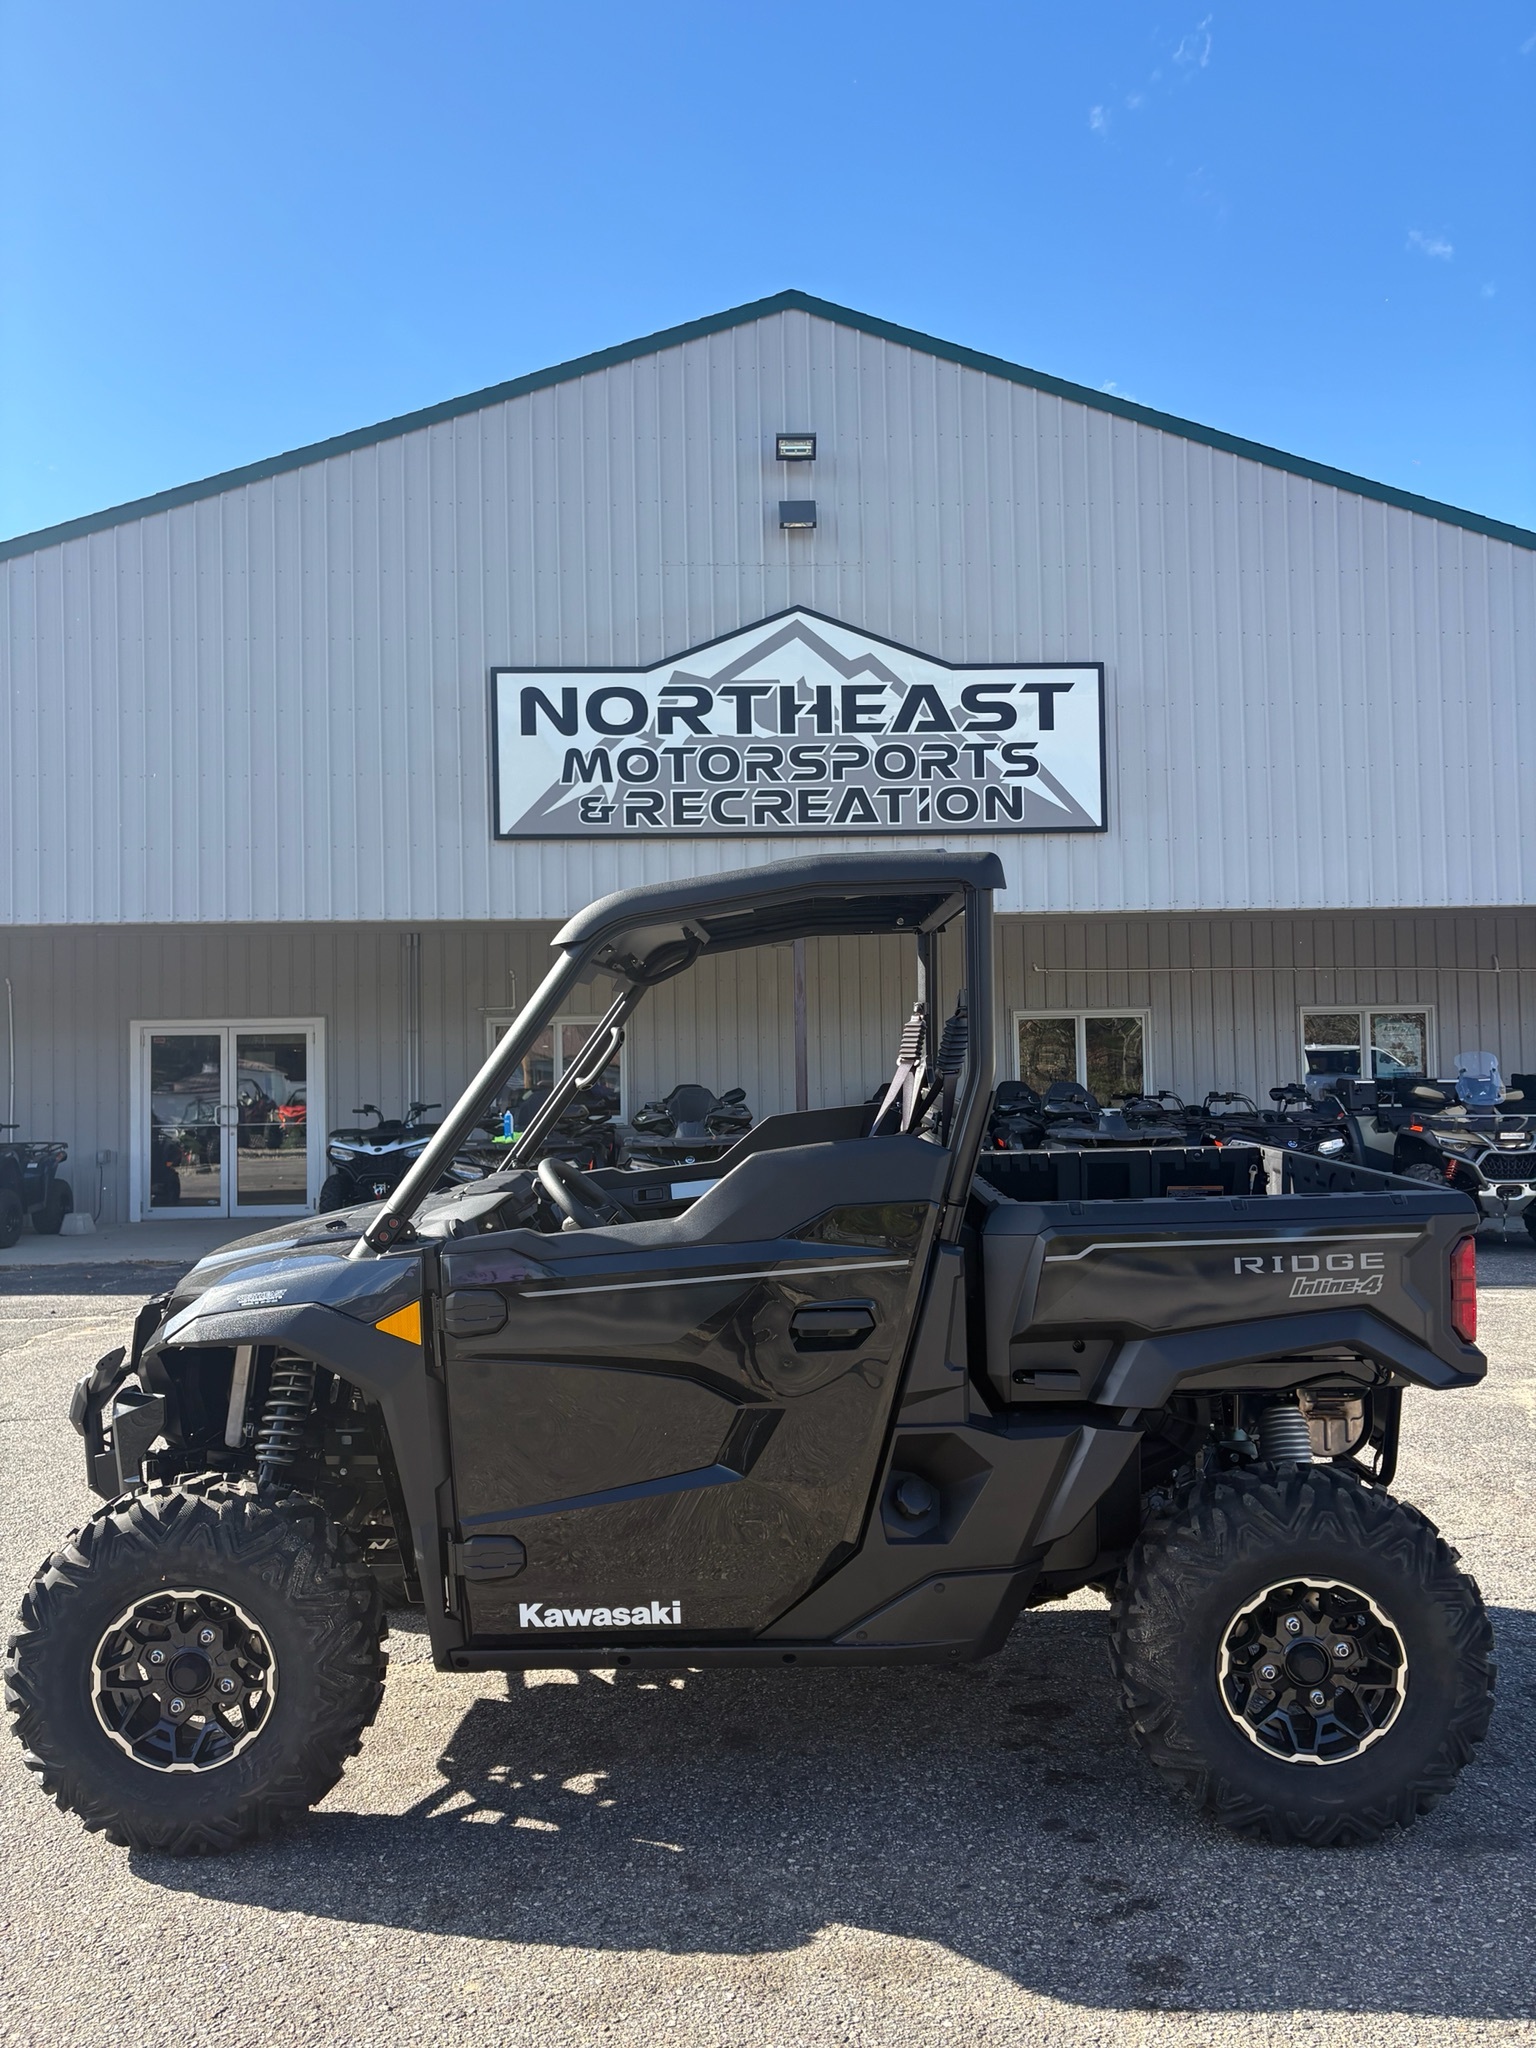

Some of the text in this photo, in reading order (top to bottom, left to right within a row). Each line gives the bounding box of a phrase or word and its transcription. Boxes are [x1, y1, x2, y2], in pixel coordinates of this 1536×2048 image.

[519, 682, 1076, 737] NORTHEAST
[560, 741, 1040, 784] MOTORSPORTS
[1233, 1252, 1385, 1275] RIDGE
[1289, 1274, 1384, 1298] Inline-4
[518, 1600, 682, 1628] Kawasaki
